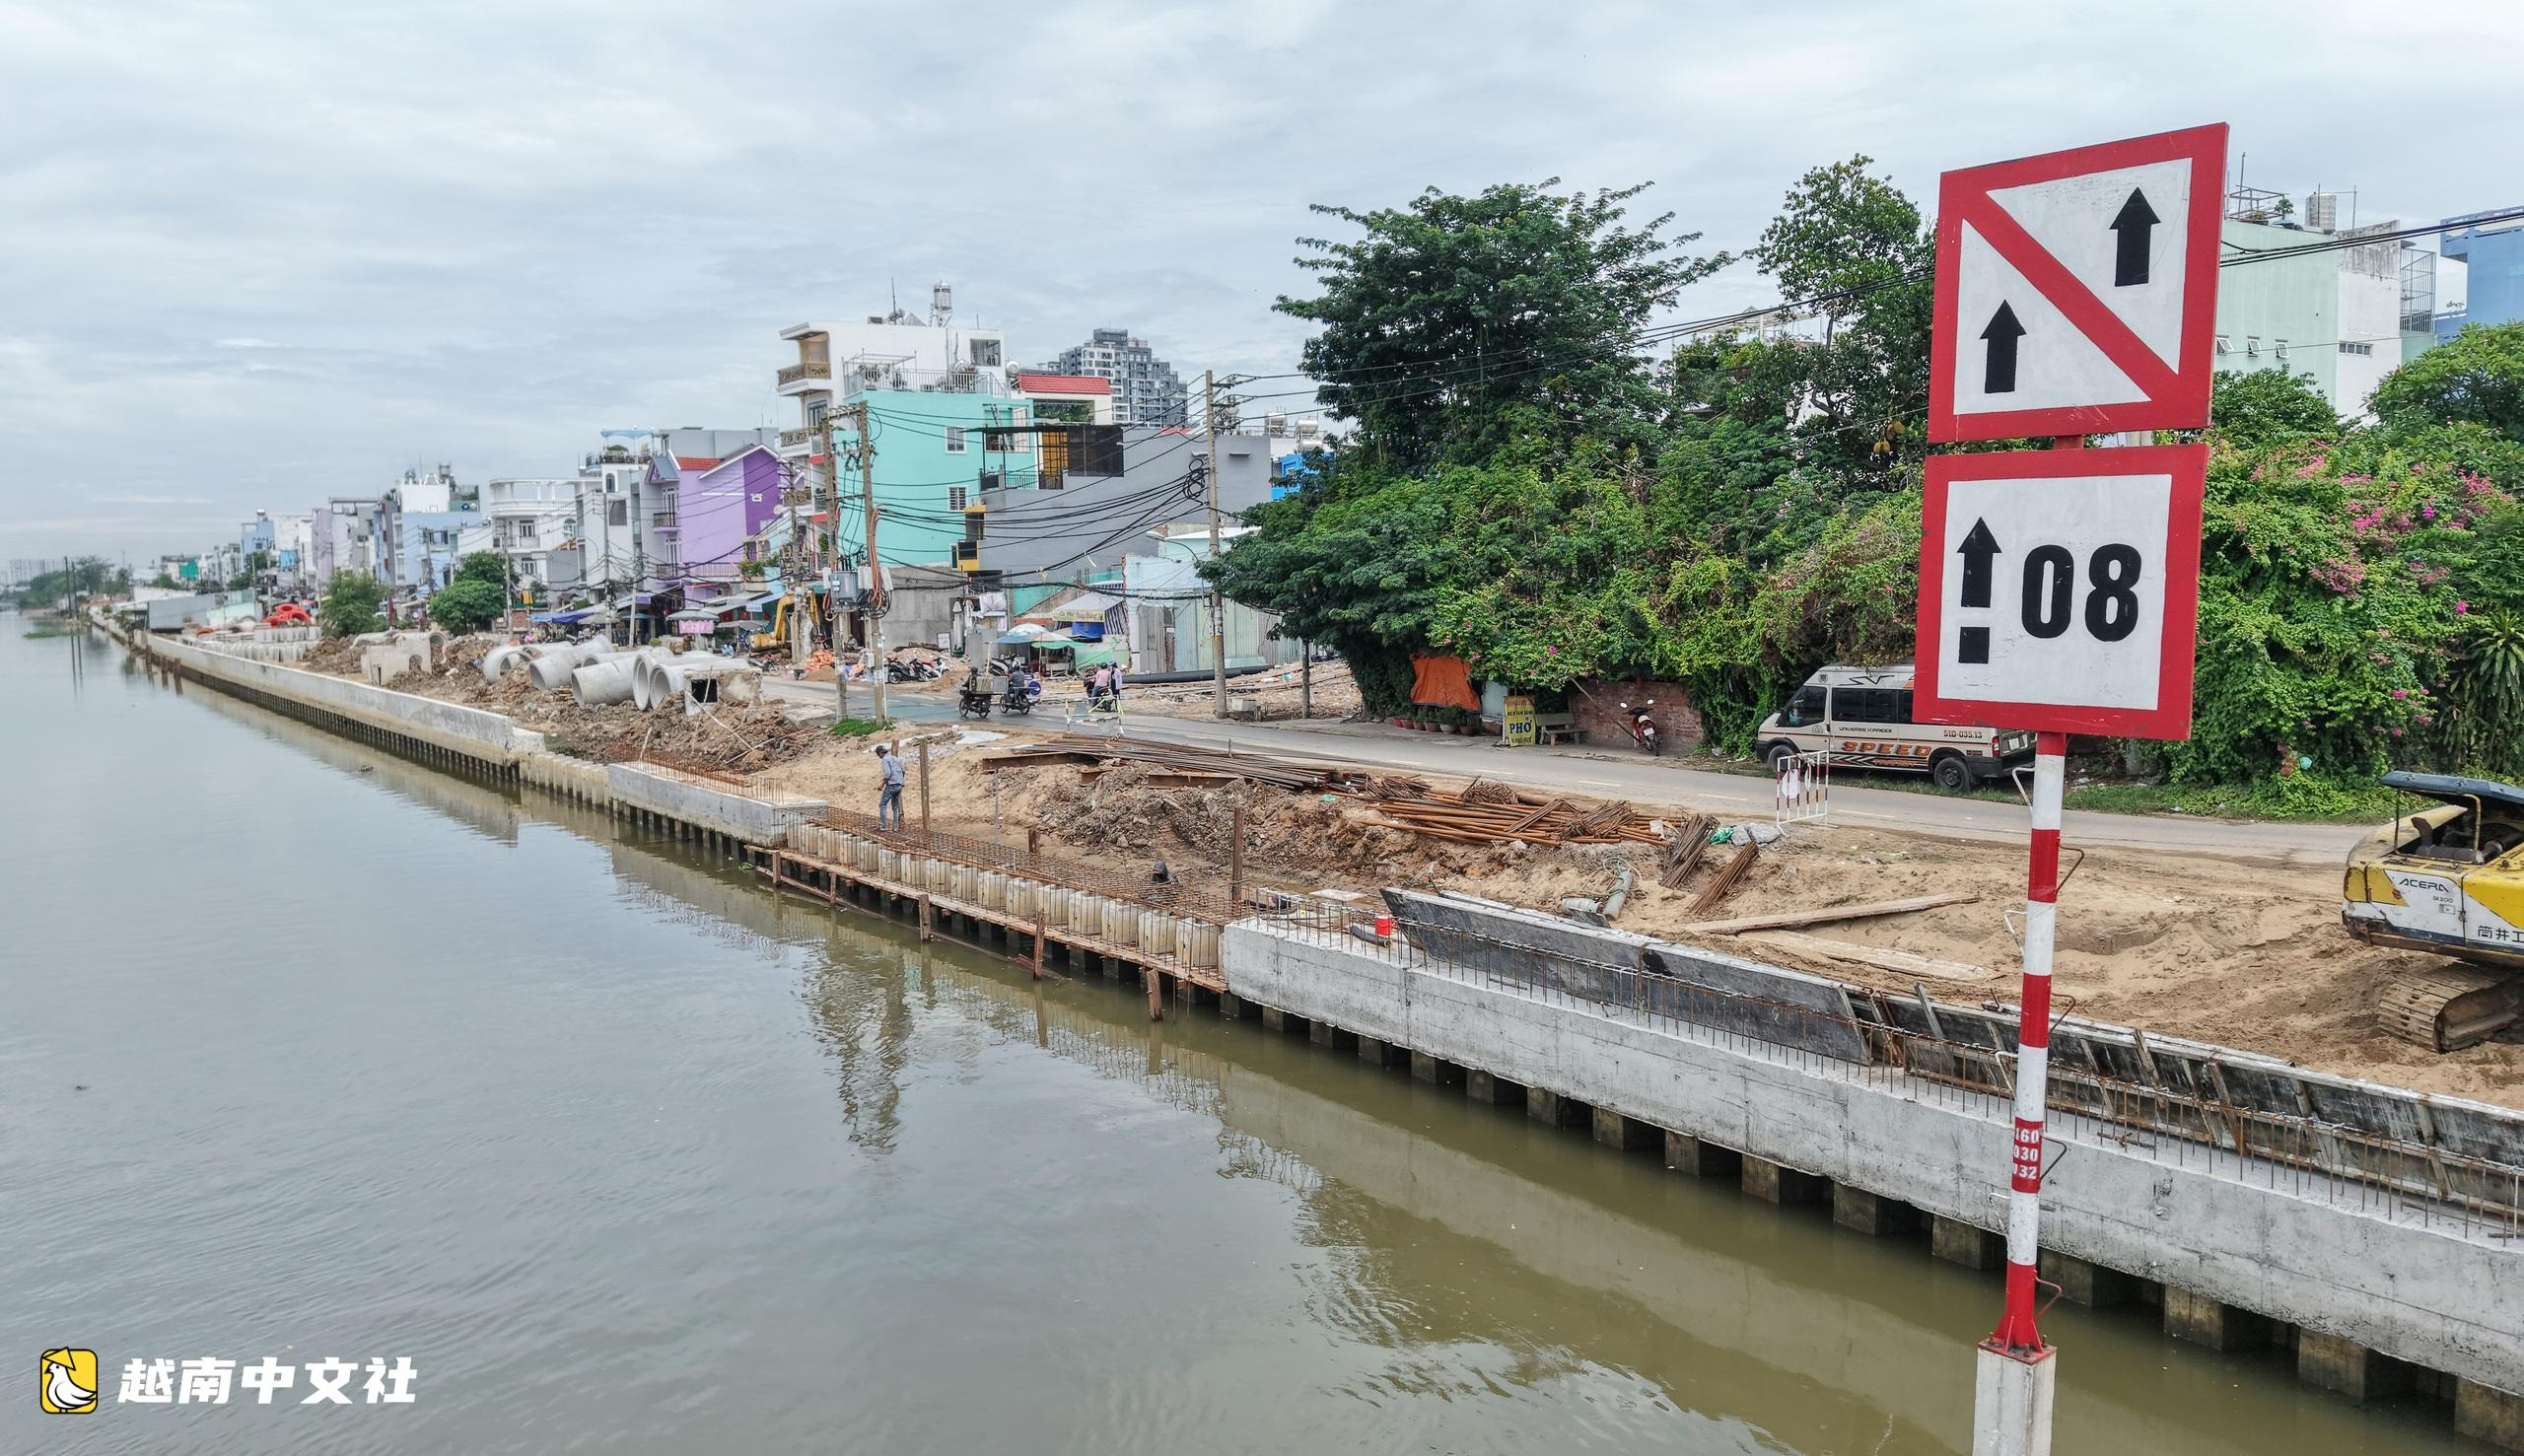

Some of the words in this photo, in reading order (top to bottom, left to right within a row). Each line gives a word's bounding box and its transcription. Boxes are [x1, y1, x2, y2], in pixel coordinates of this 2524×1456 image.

[2021, 543, 2141, 643] 08
[1509, 717, 1533, 733] PHỞ
[1841, 741, 1931, 757] SPEED
[2399, 878, 2450, 892] ACERA
